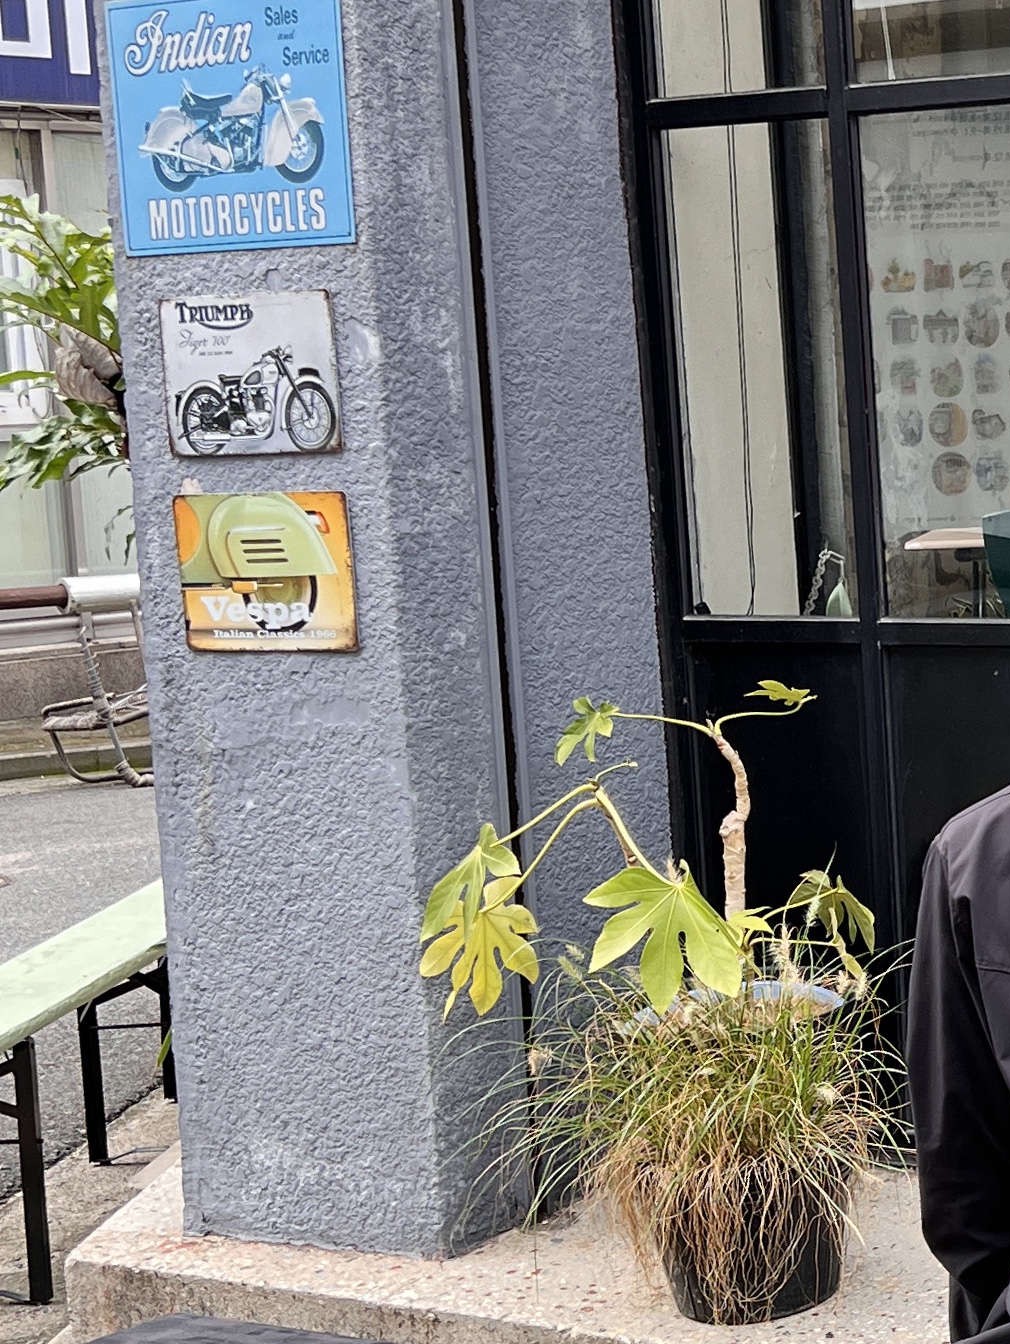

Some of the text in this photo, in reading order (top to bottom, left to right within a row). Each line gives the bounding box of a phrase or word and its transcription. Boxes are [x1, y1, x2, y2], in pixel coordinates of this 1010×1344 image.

[264, 5, 298, 26] Sales
[124, 10, 252, 76] Indian
[282, 44, 330, 67] Service
[149, 187, 326, 241] MOTORCYCLES
[175, 301, 253, 324] TRIUMPH
[200, 596, 313, 629] Vespa
[213, 629, 254, 639] Italian
[257, 629, 305, 639] Classics
